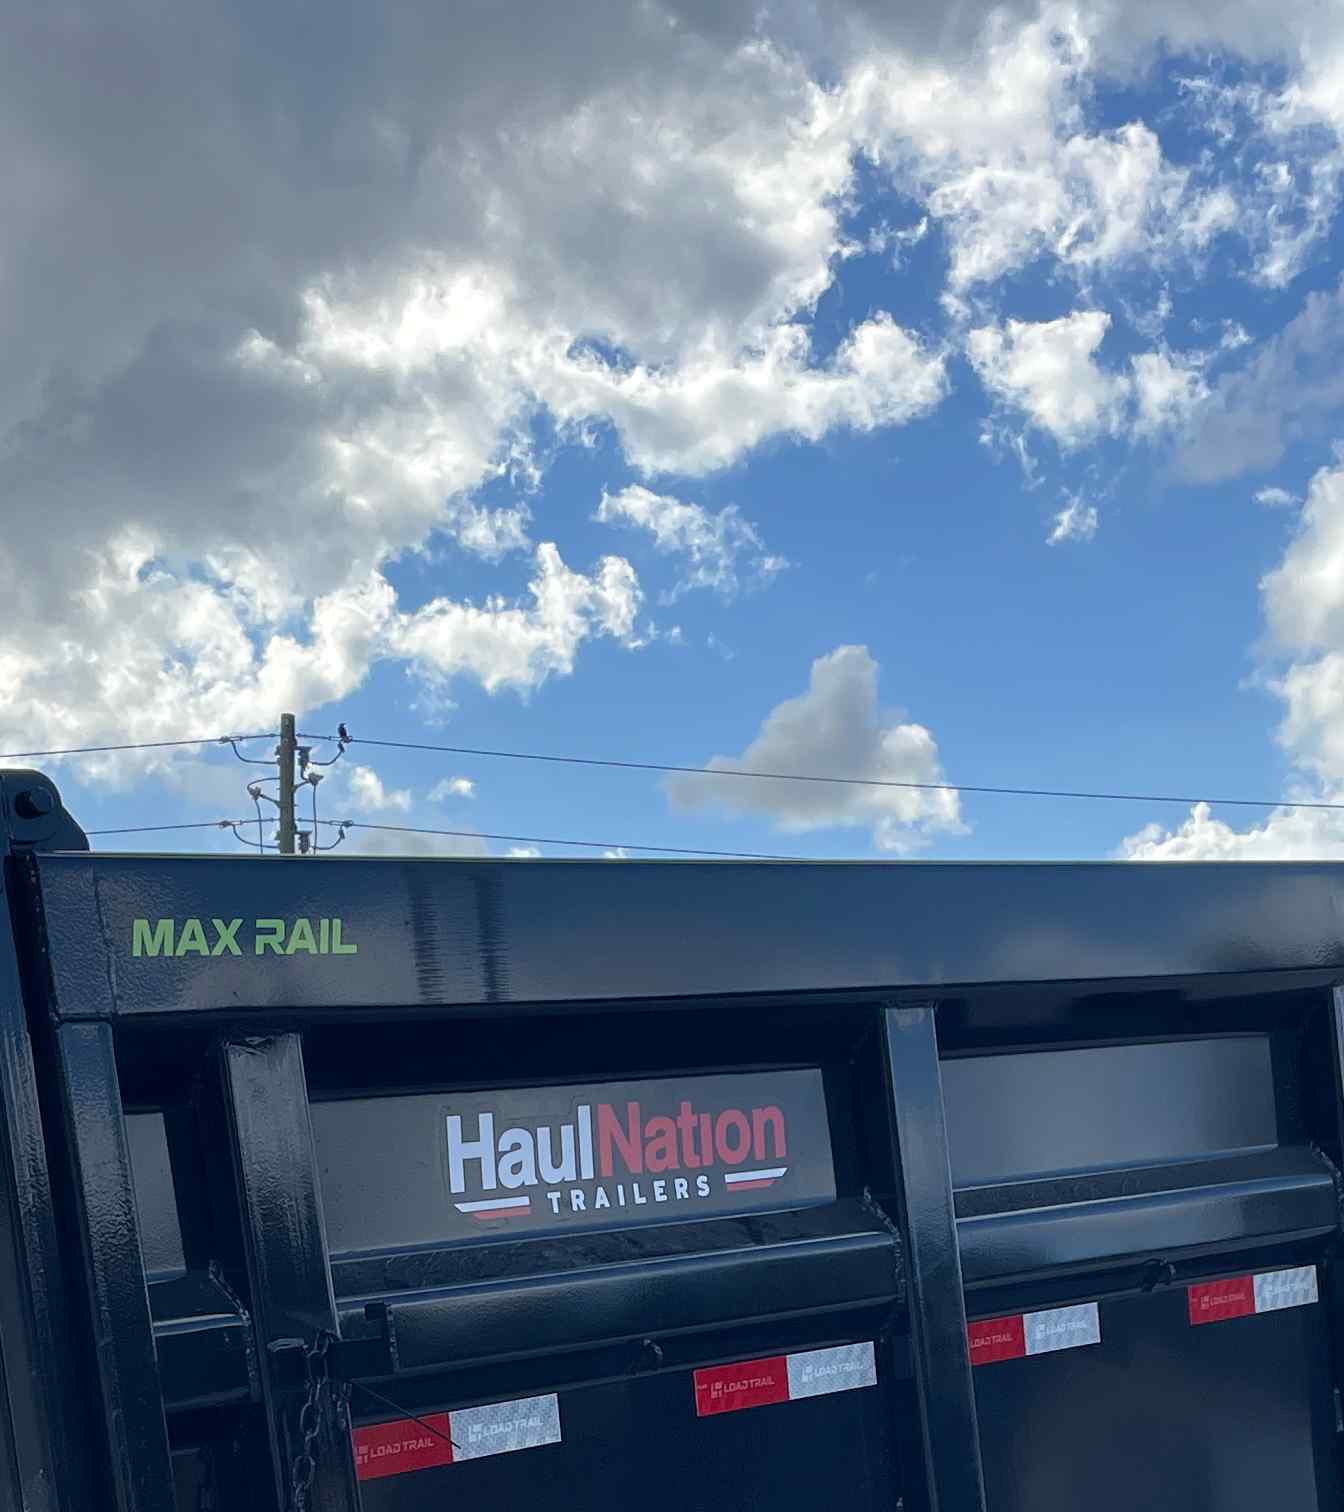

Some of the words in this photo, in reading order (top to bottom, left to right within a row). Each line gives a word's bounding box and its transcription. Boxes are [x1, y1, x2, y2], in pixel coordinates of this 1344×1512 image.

[132, 918, 243, 957] MAX
[255, 918, 358, 955] RAIL
[446, 1101, 787, 1194] HaulNation
[547, 1175, 711, 1214] TRAILERS
